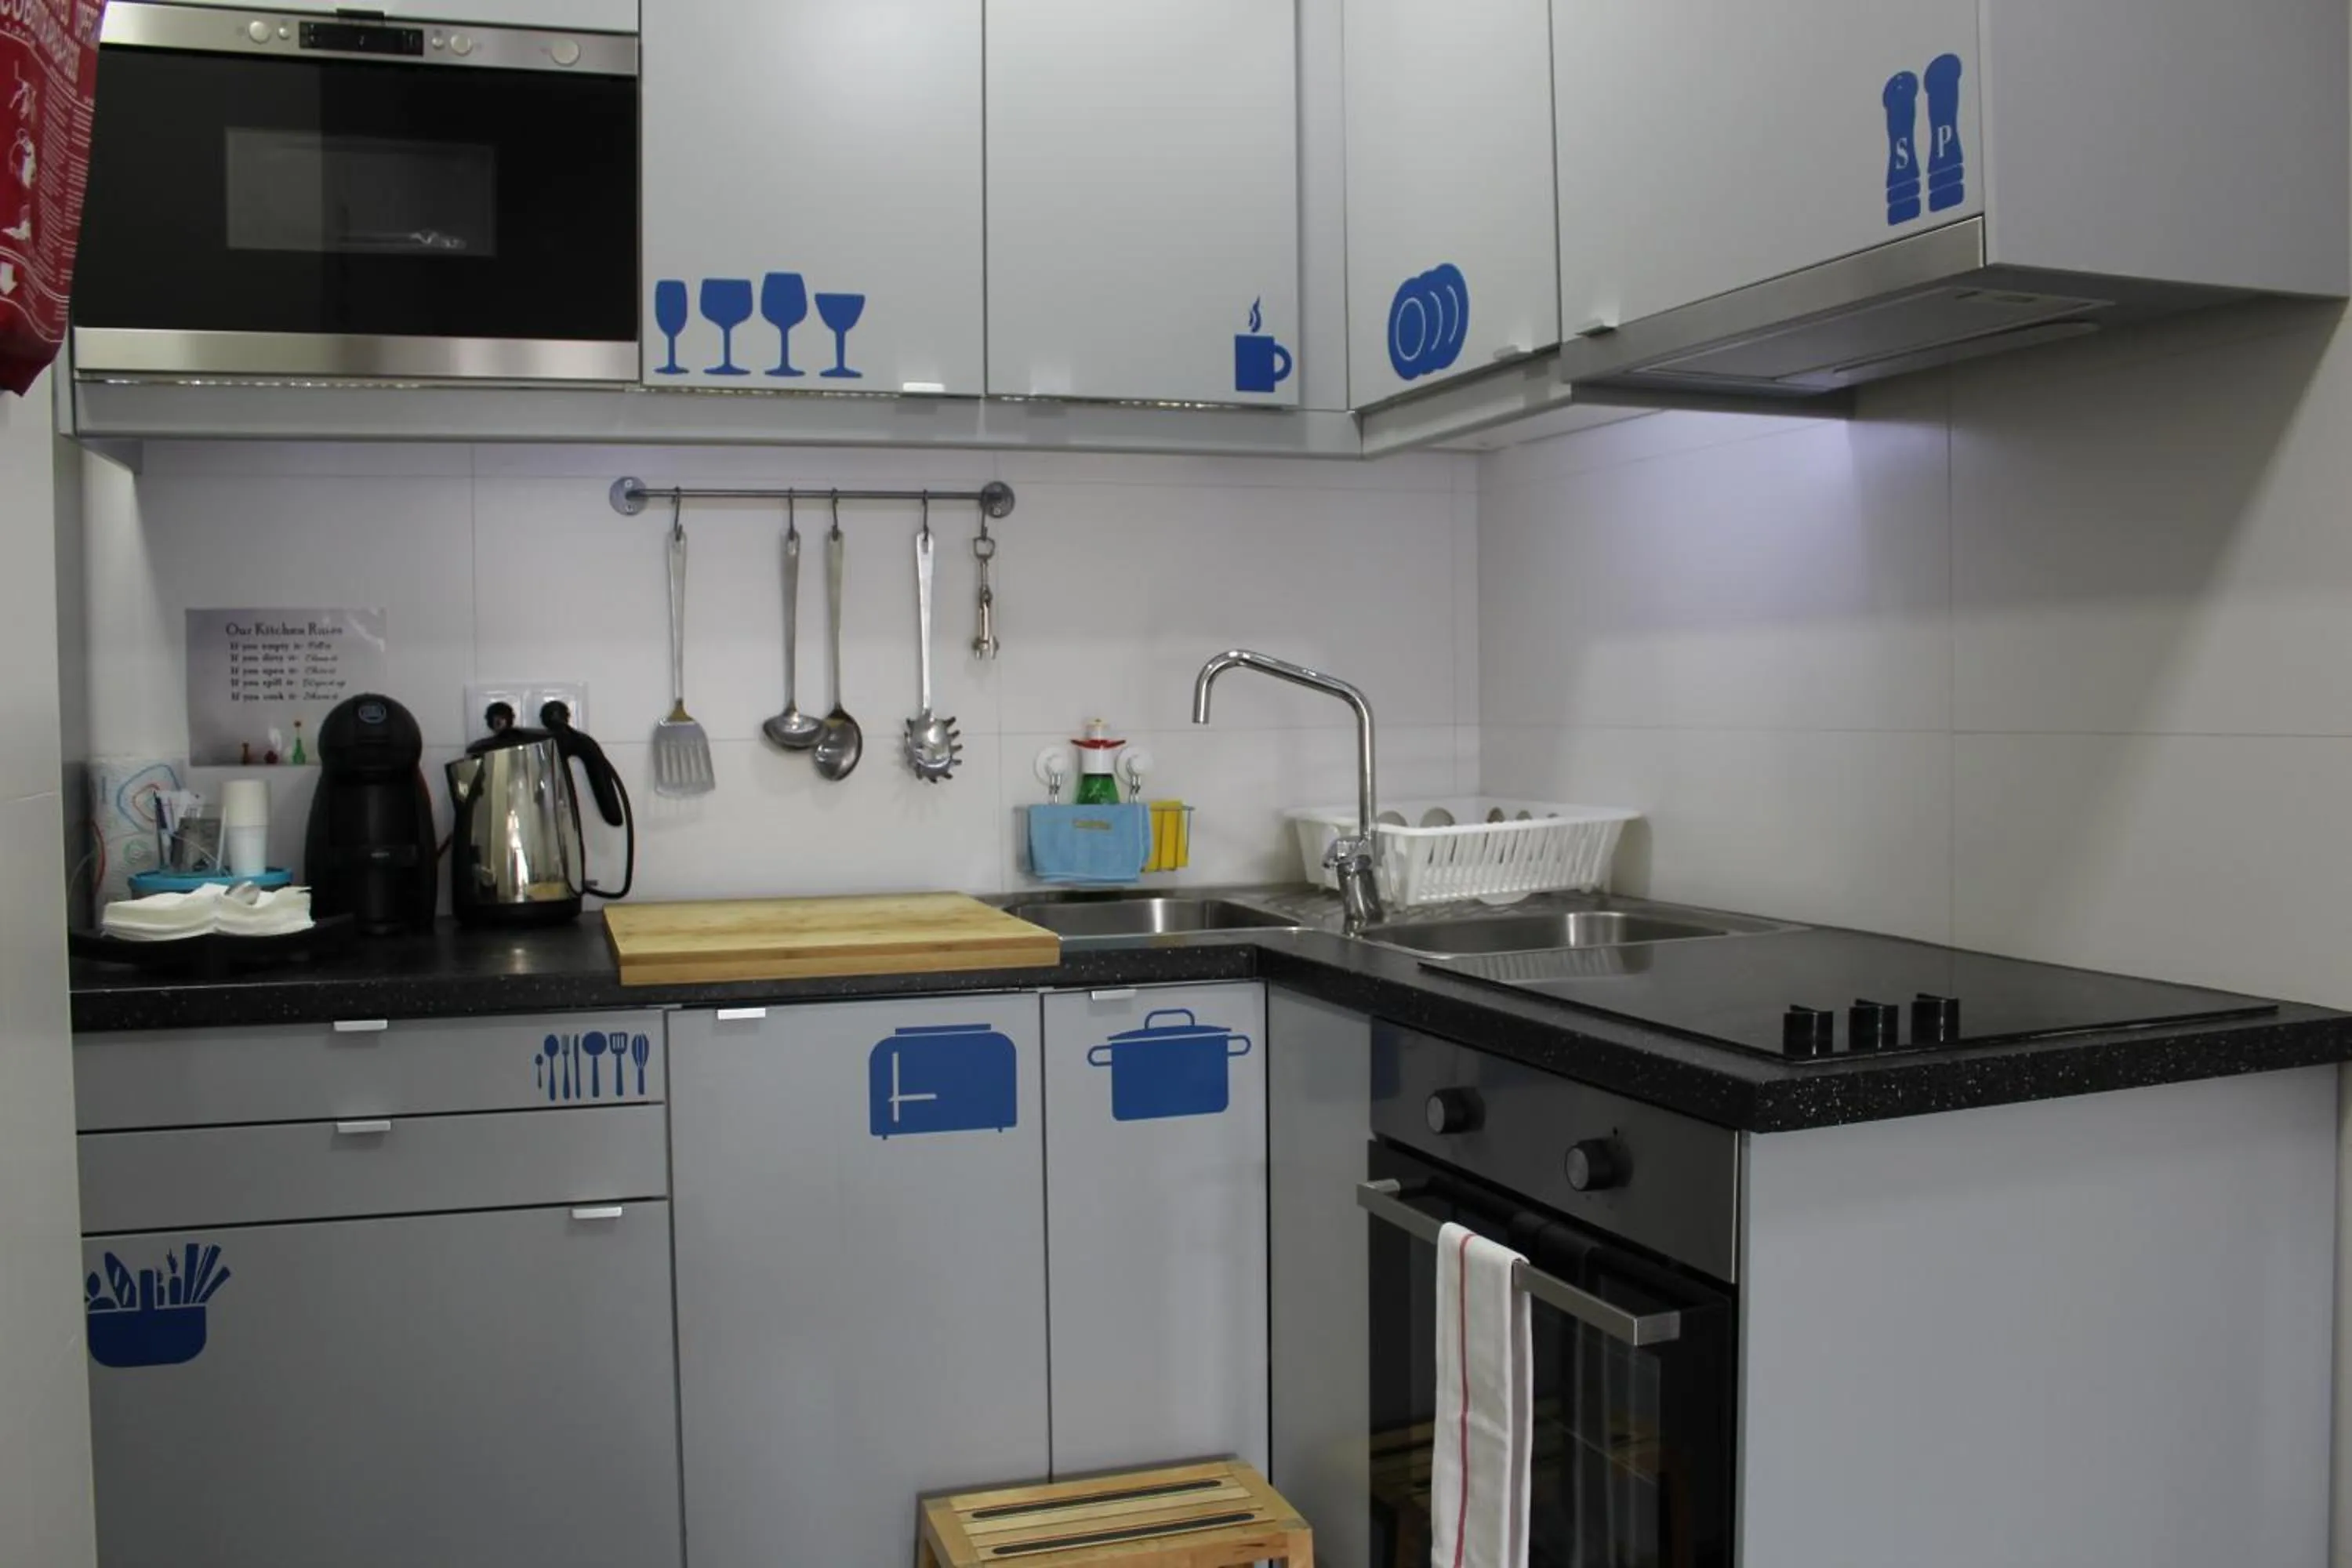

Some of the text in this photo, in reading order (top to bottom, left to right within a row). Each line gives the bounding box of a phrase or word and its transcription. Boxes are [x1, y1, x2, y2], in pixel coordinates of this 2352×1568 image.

[1895, 125, 1951, 170] S P
[225, 622, 252, 636] Our
[255, 622, 305, 636] Kitchen
